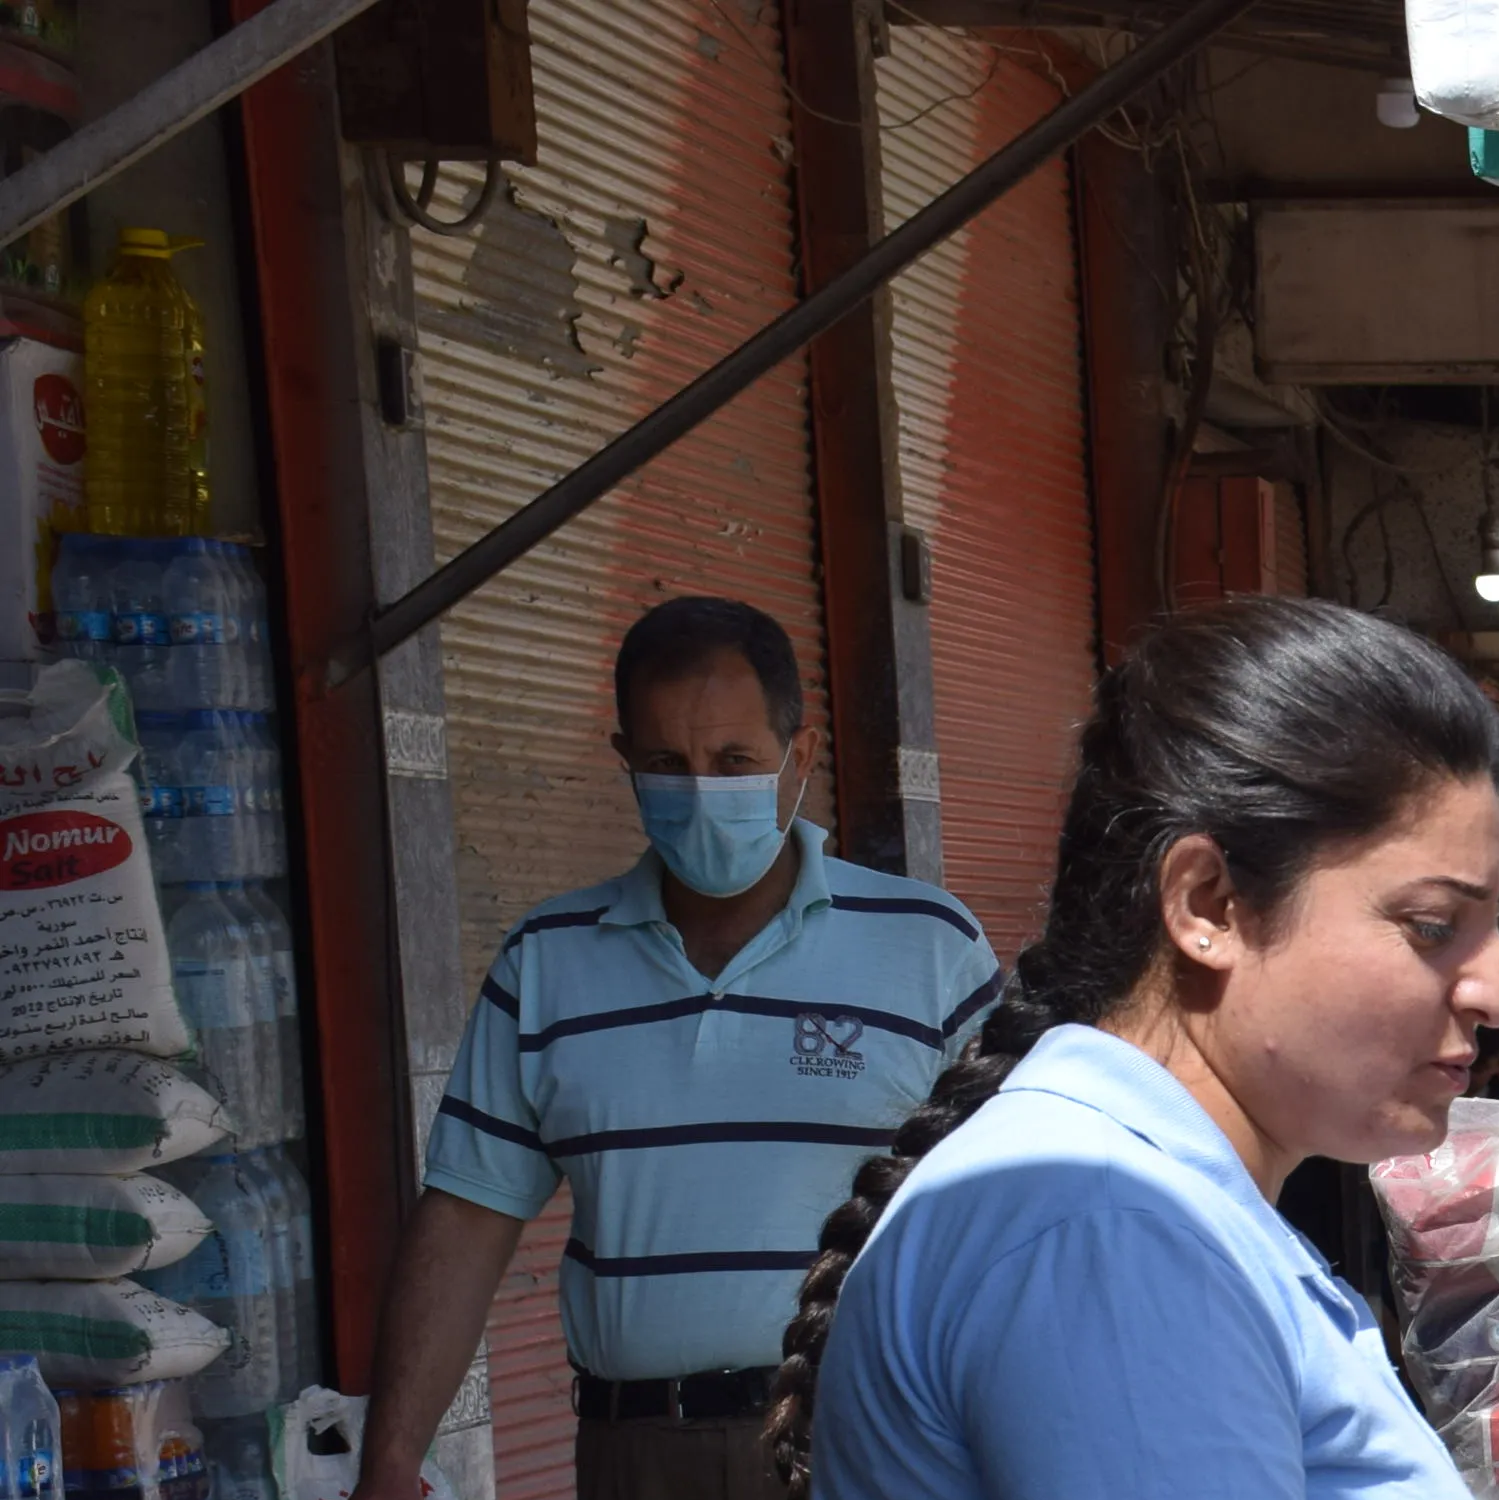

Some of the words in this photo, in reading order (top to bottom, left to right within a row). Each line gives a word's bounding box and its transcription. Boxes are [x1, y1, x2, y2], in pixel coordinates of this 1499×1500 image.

[2, 825, 121, 862] Nomur
[10, 854, 80, 887] Salt
[797, 1066, 834, 1077] SINCE
[836, 1069, 859, 1080] 1917
